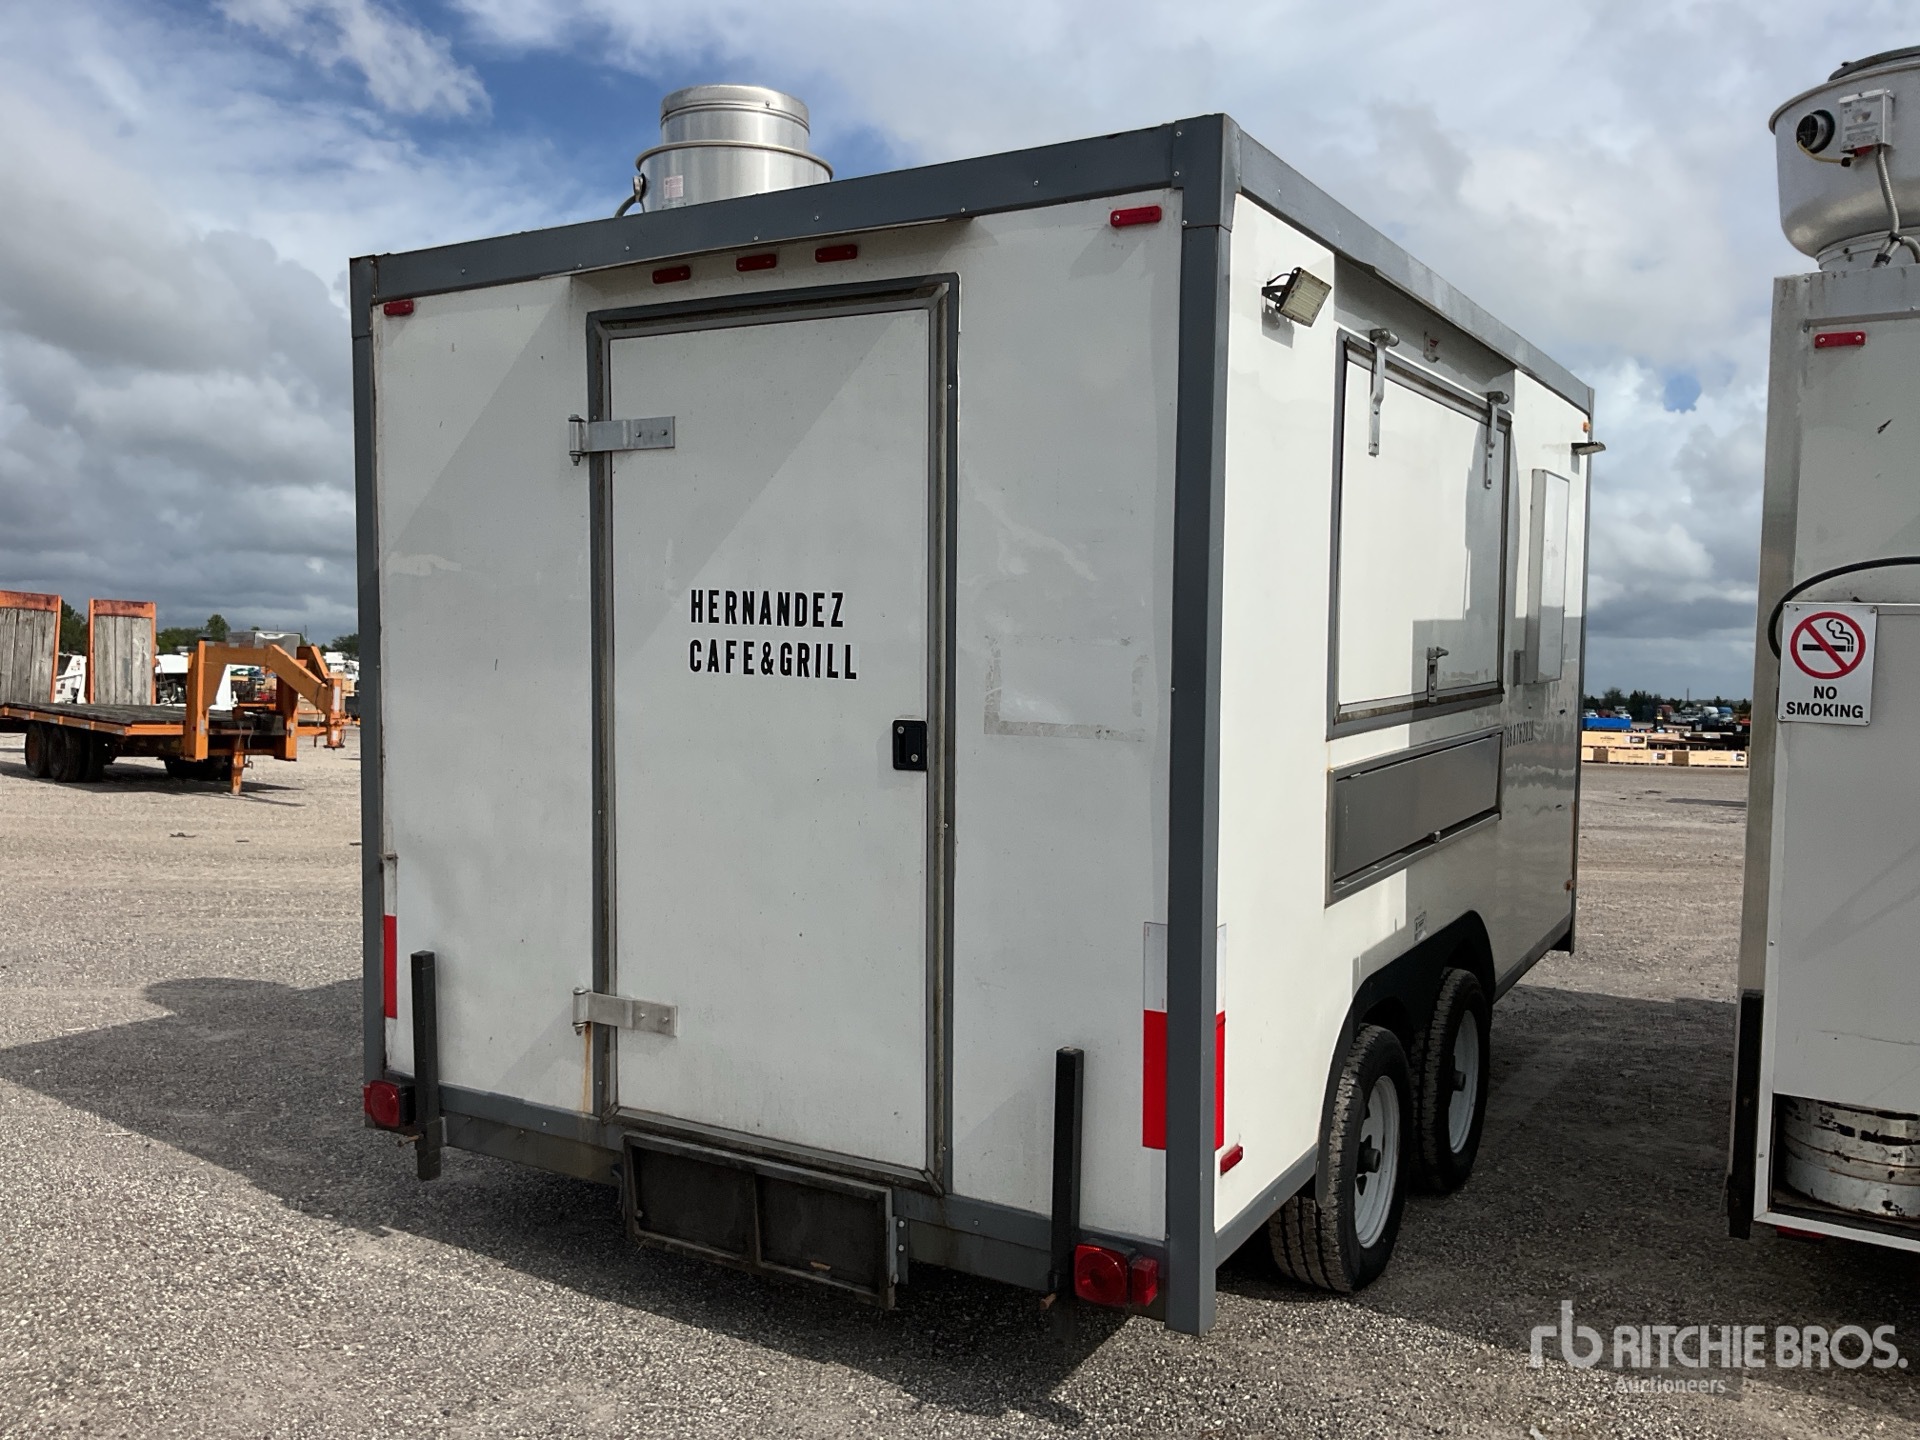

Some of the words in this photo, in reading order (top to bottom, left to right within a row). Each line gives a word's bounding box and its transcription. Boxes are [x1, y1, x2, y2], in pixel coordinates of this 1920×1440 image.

[690, 589, 844, 628] HERNANDEZ
[689, 639, 857, 680] CAFE&GRILL
[1813, 686, 1838, 700] NO
[1786, 701, 1864, 719] SMOKING
